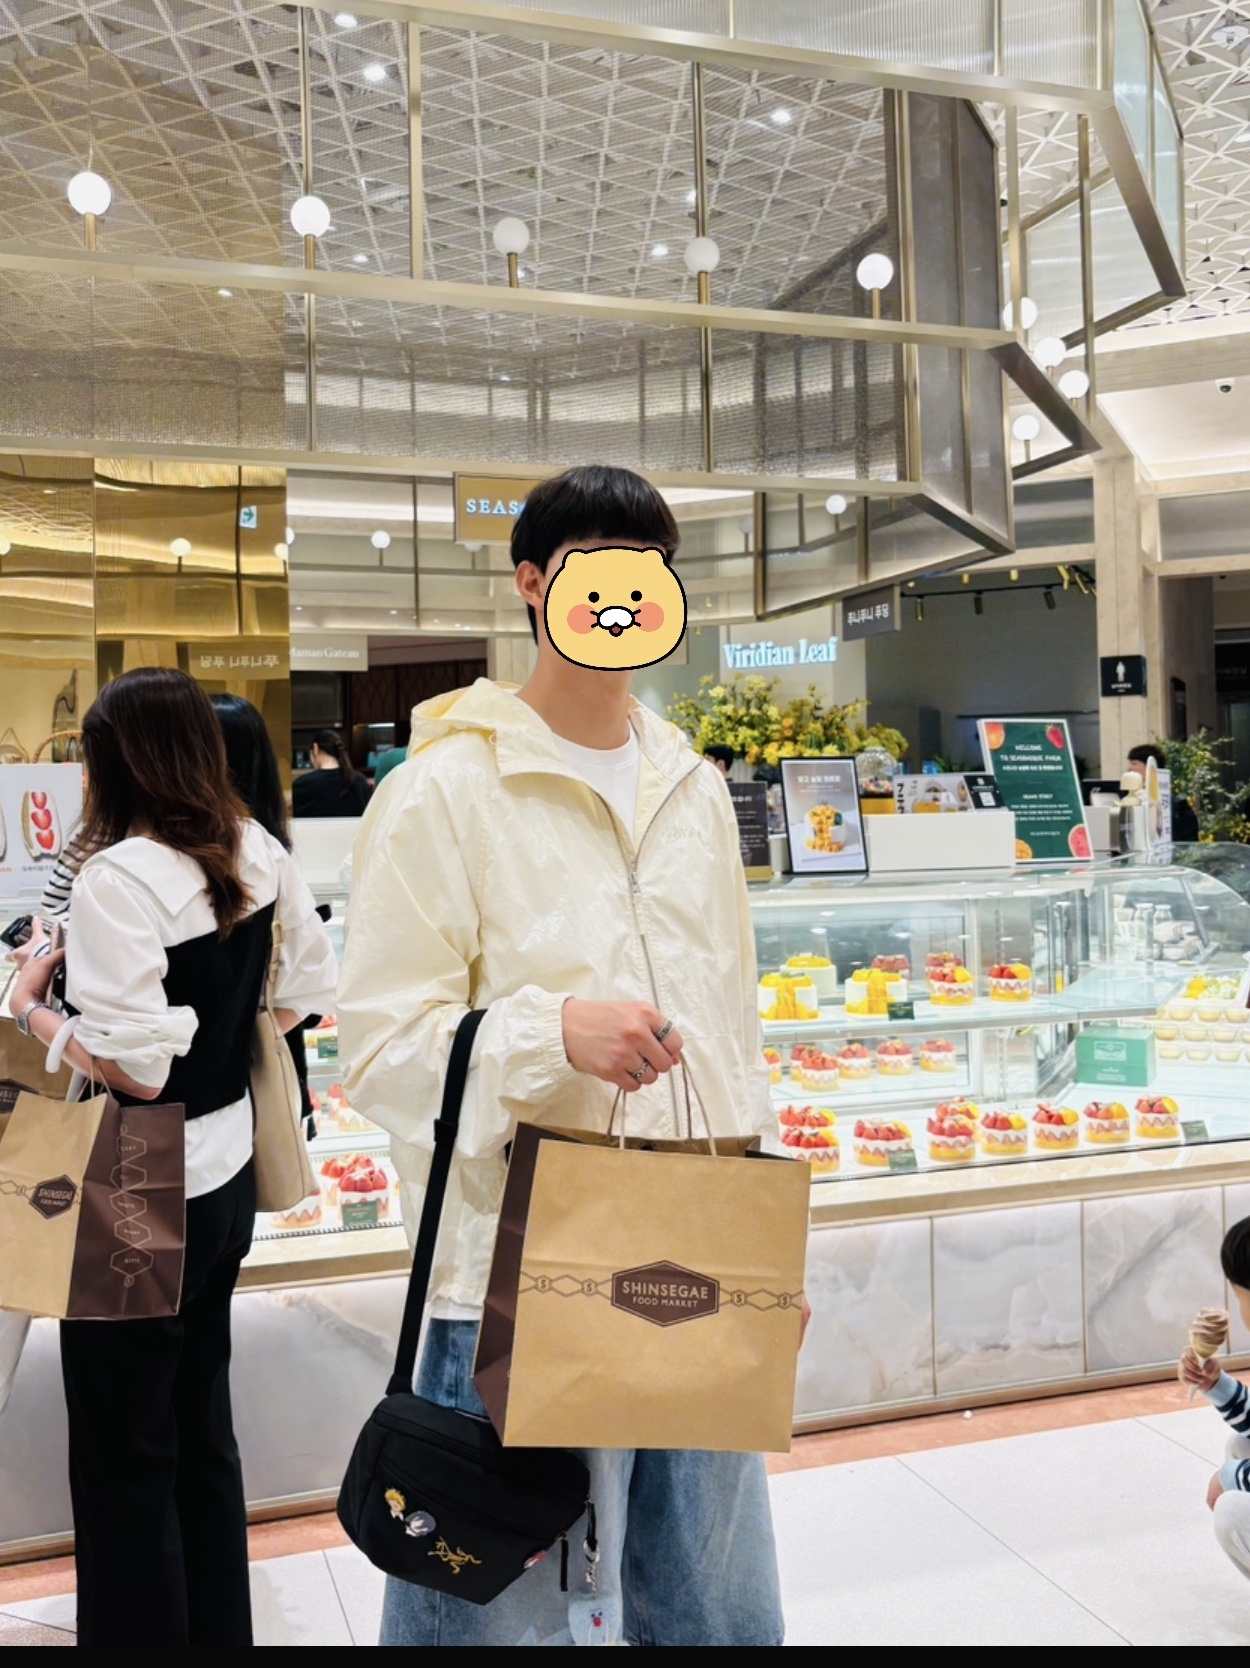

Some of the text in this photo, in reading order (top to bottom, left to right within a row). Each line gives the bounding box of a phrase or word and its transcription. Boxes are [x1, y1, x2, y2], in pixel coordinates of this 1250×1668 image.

[323, 647, 360, 659] Gateau
[723, 636, 838, 669] Viridian Leaf
[622, 1280, 708, 1299] SHINSEGAE
[632, 1296, 698, 1308] FOOD MARKET
